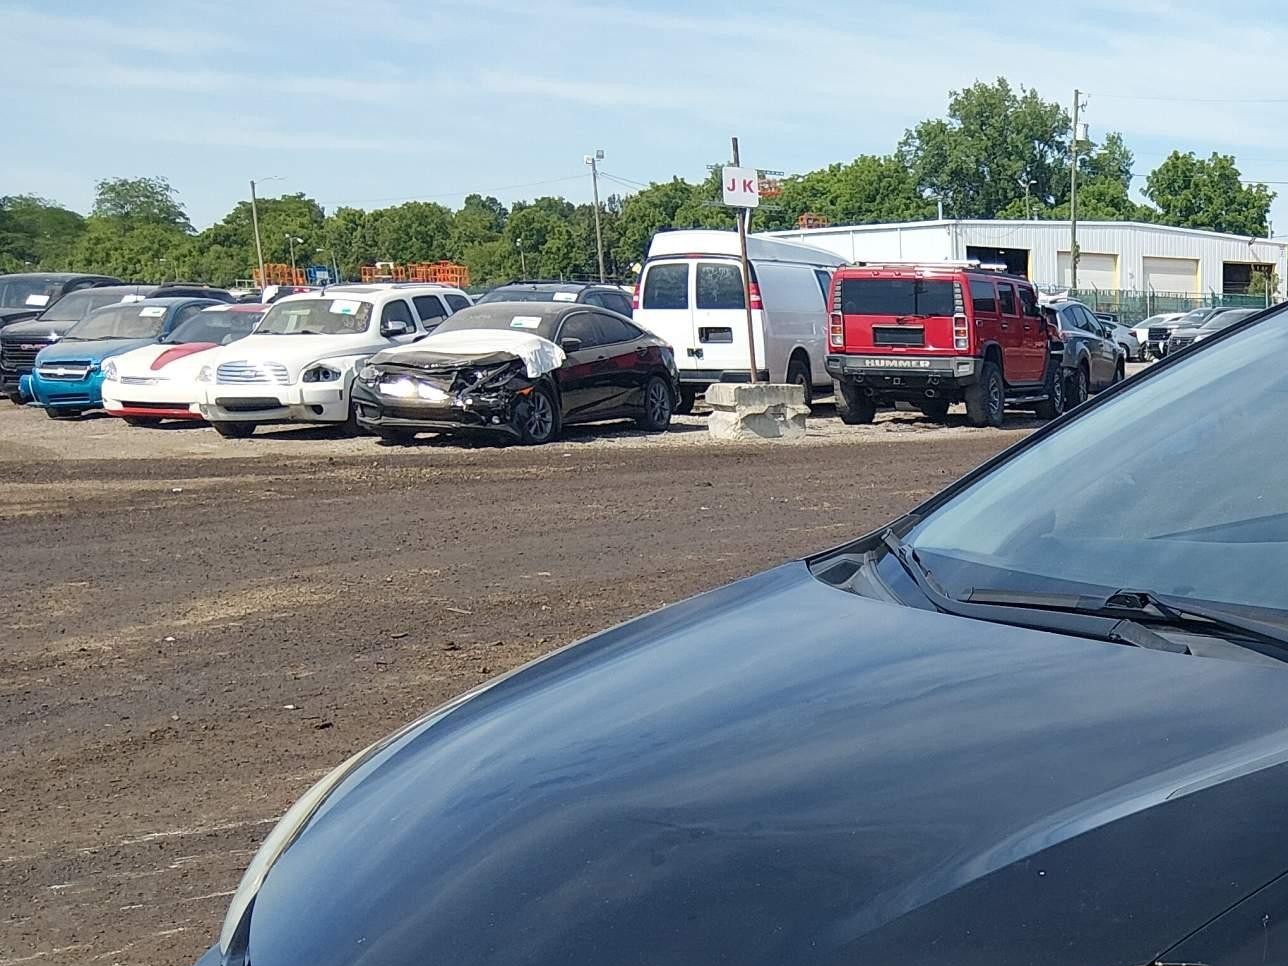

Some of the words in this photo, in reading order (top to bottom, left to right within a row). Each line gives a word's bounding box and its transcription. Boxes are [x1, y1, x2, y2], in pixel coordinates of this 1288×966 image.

[726, 178, 736, 191] J
[742, 179, 755, 193] K
[864, 359, 930, 368] HUMMER
